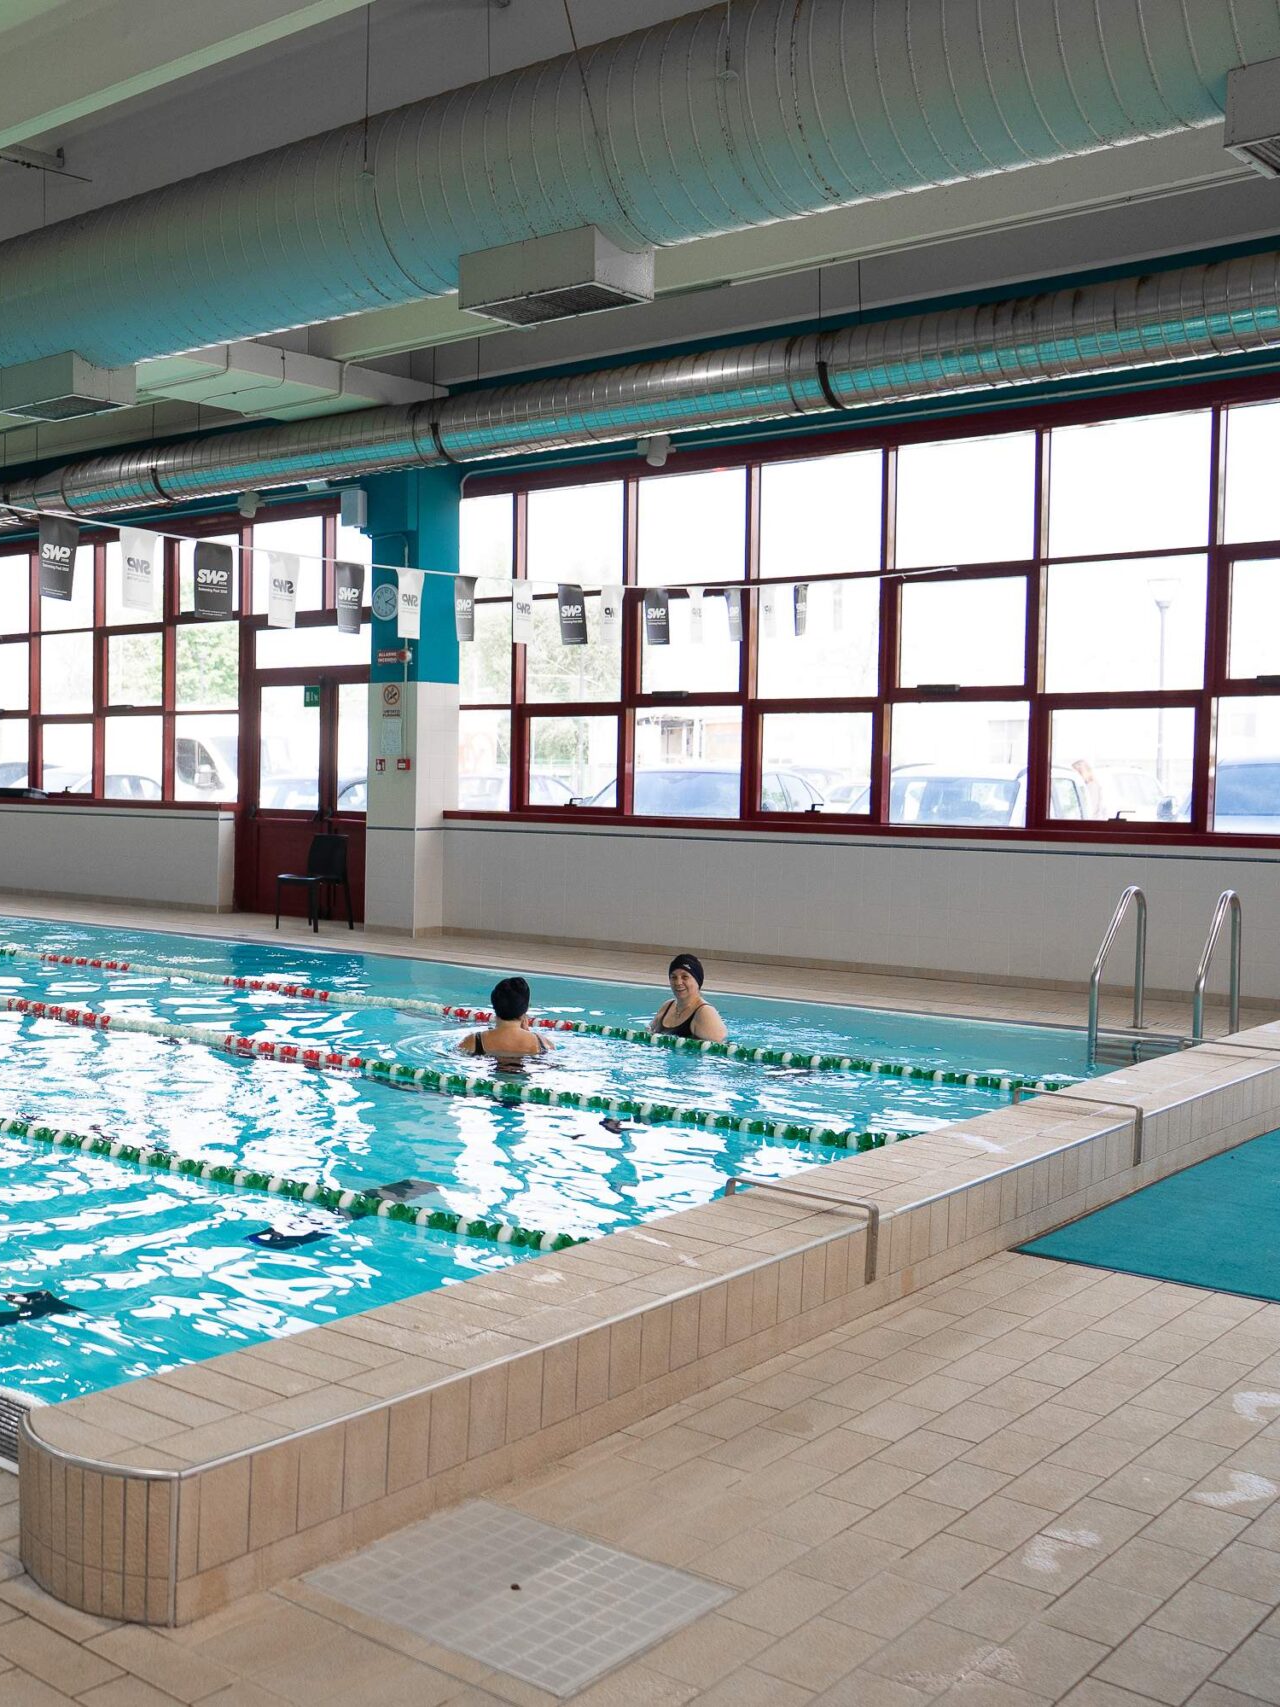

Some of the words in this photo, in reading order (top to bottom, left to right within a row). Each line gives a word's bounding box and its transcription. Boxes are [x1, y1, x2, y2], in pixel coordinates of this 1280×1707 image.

[41, 543, 71, 561] SWP
[197, 568, 228, 585] SWP
[338, 586, 360, 602] SWP
[456, 599, 471, 612] SWP
[561, 604, 582, 617] SWP
[647, 607, 667, 619] SWP
